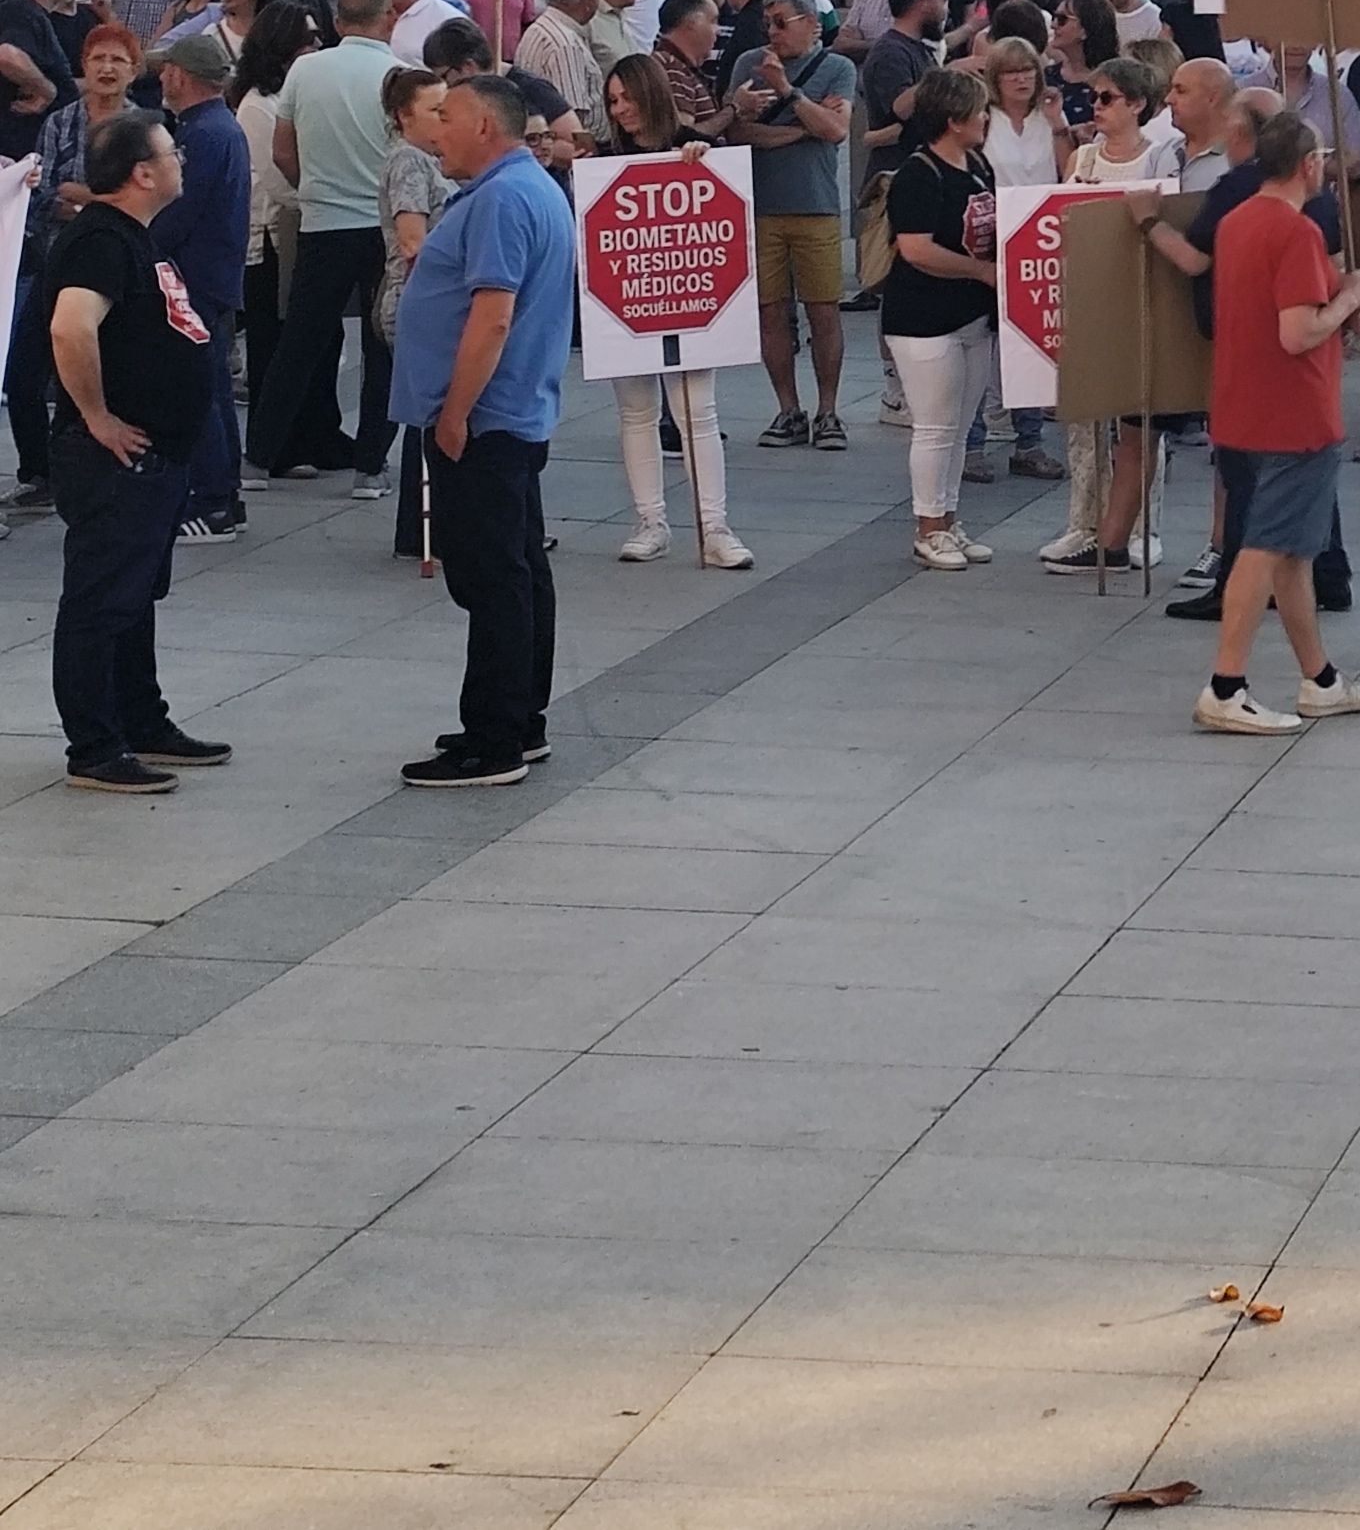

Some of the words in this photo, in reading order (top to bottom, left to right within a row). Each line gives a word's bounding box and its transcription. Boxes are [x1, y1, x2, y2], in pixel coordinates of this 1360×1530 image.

[615, 179, 716, 221] STOP
[599, 219, 734, 253] BIOMETANO
[609, 260, 621, 276] Y
[627, 246, 727, 274] RESIDUOS
[622, 272, 714, 300] MÉDICOS
[1029, 288, 1042, 305] Y
[623, 297, 718, 319] SOCUÉLLAMOS
